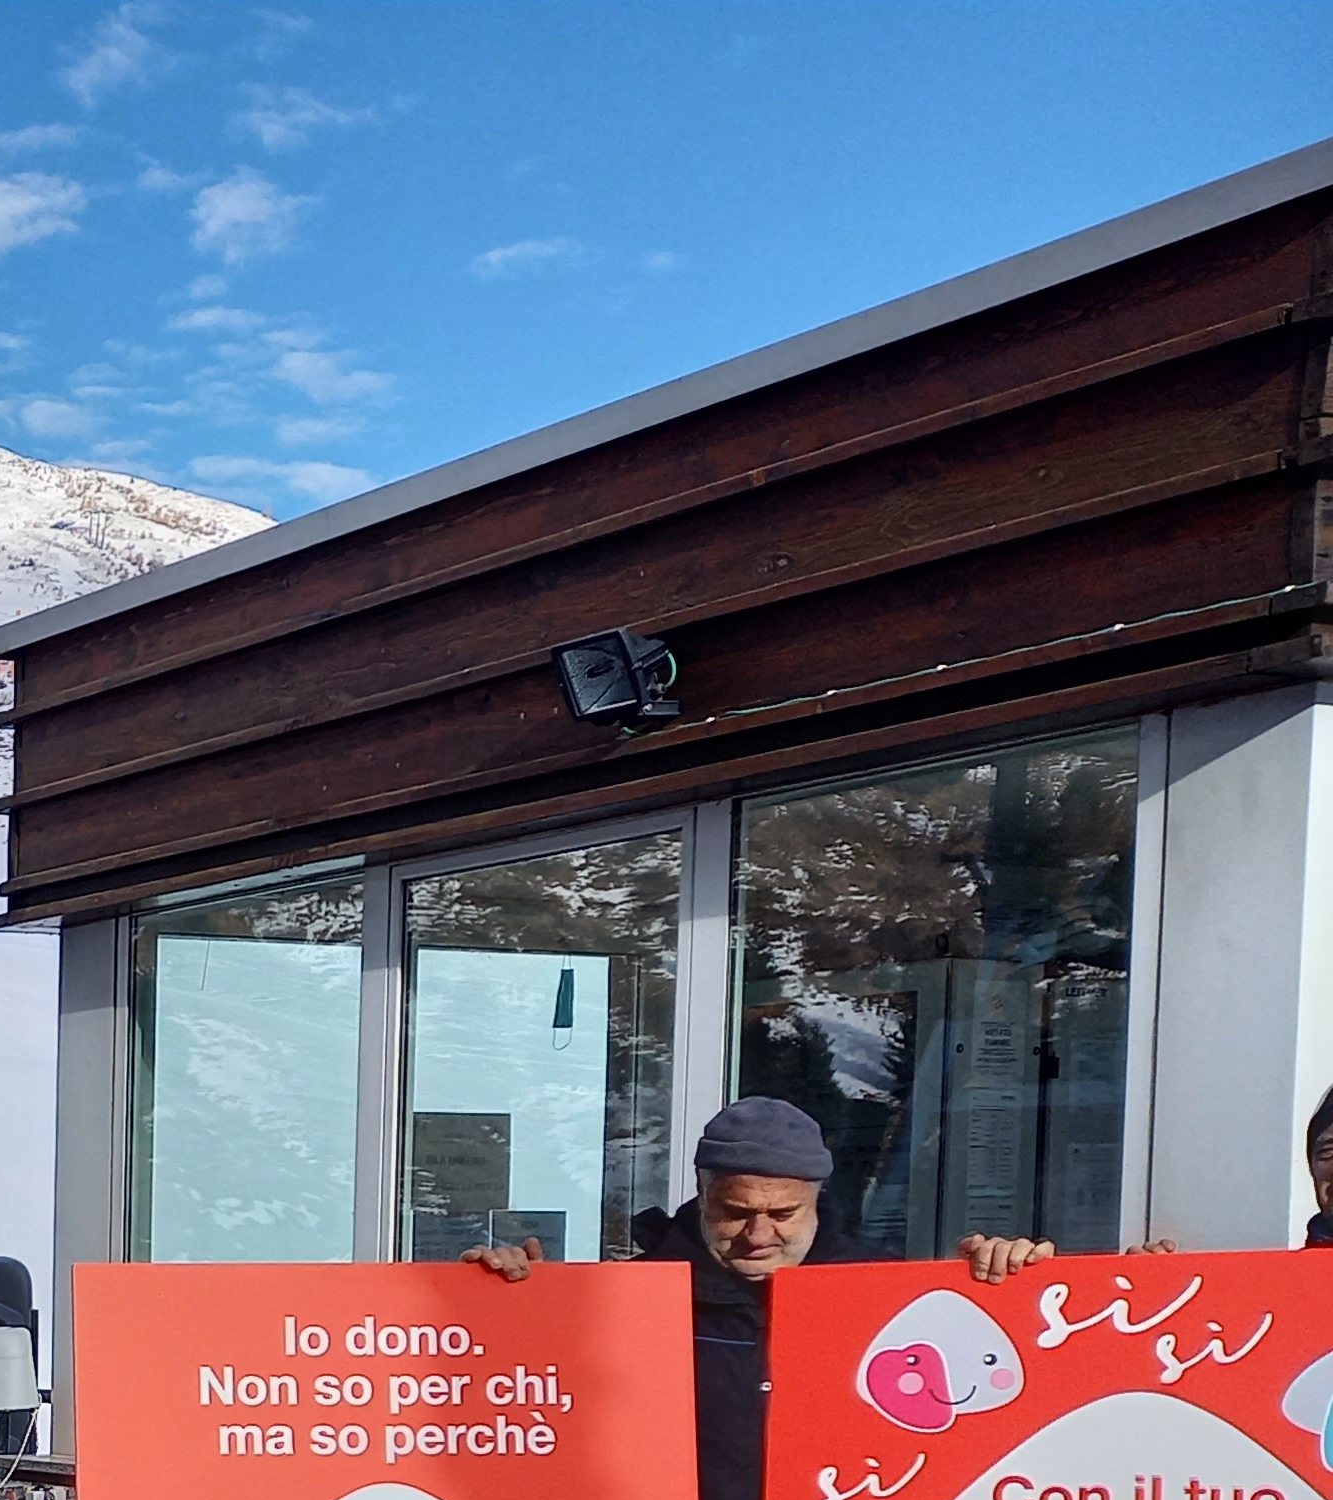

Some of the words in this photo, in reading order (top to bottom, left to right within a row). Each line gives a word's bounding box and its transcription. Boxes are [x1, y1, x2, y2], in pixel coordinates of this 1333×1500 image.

[284, 1315, 331, 1356] Io
[345, 1316, 485, 1357] dono.
[199, 1366, 305, 1406] Non
[313, 1375, 375, 1406] so
[389, 1373, 472, 1415] per
[485, 1366, 573, 1412] chi,
[218, 1424, 301, 1456] ma
[311, 1424, 369, 1456] so
[385, 1410, 557, 1464] perchè
